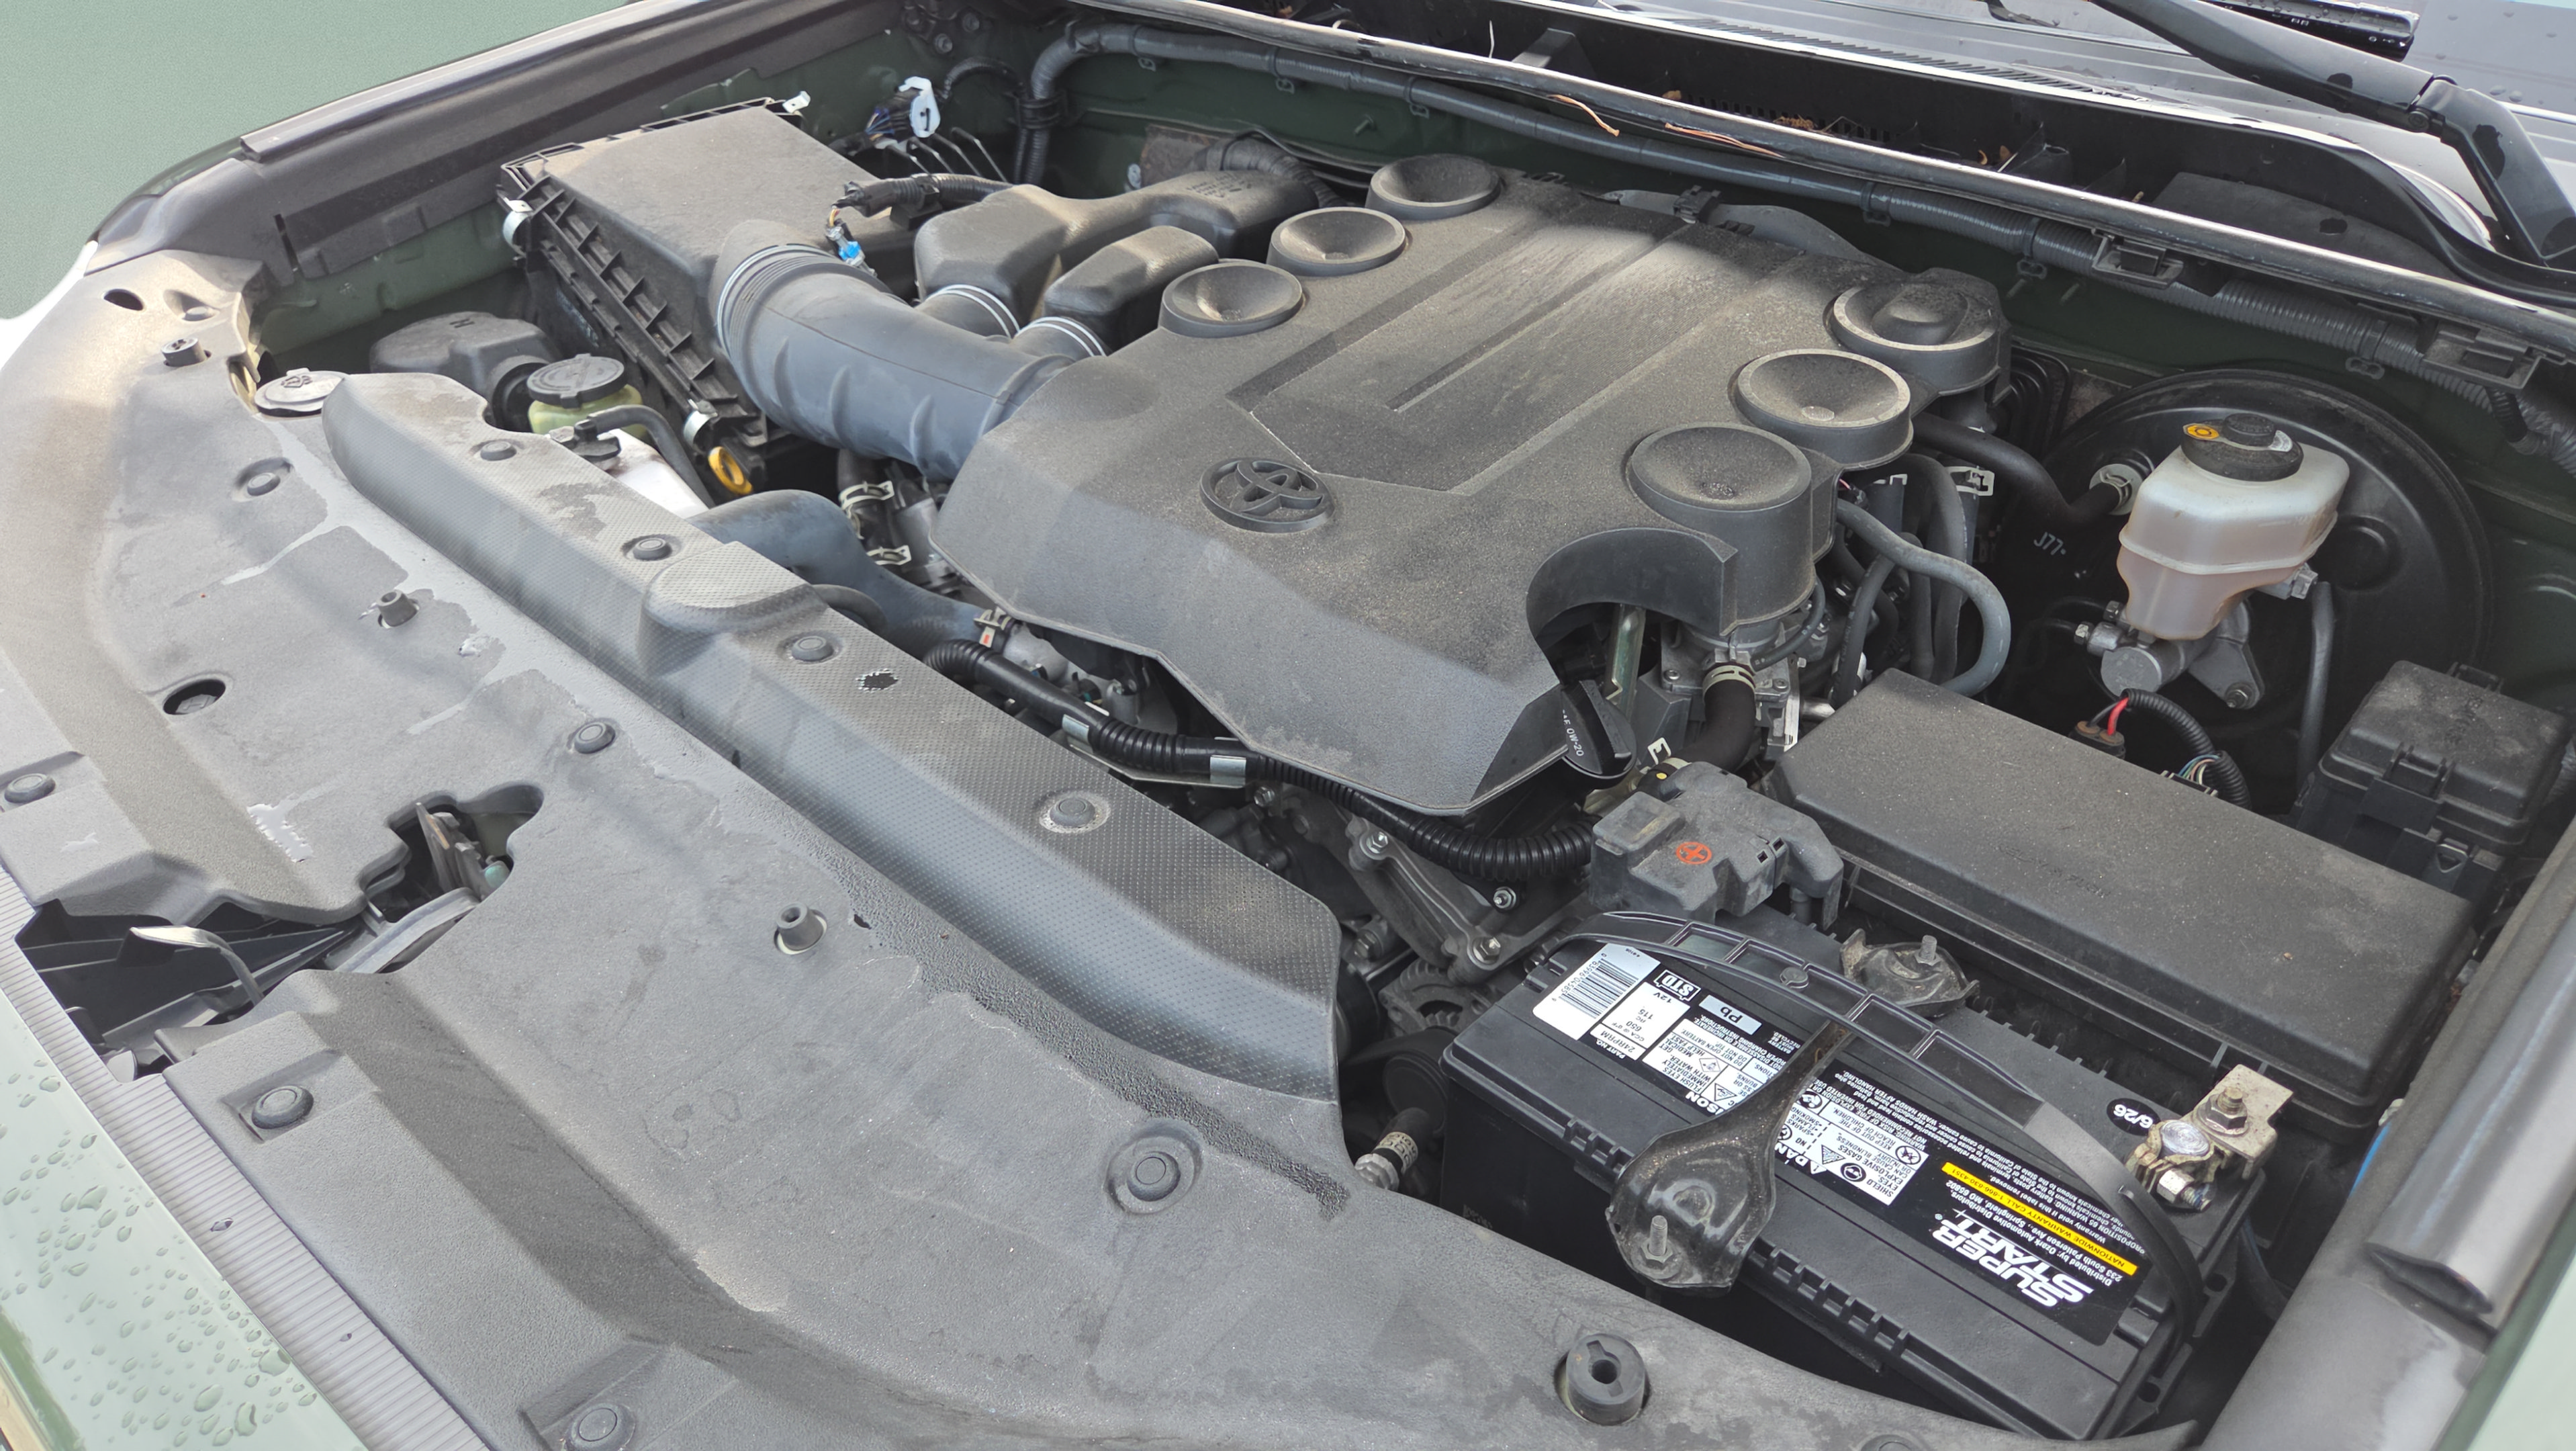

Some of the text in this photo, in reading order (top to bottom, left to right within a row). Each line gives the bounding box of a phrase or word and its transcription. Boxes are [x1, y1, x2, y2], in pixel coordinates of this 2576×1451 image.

[1566, 728, 1585, 757] 0W-20
[1559, 975, 1581, 994] 04585
[1661, 975, 1694, 996] STD
[1653, 992, 1672, 1004] 12V
[1635, 1016, 1647, 1024] RC
[1638, 1008, 1653, 1020] 115
[1720, 1006, 1743, 1024] Pb
[1625, 1020, 1643, 1032] 650
[1694, 1017, 1725, 1039] INCINERATE.
[1600, 1030, 1636, 1053] 24RPRM
[1630, 1031, 1645, 1042] CCA
[1700, 1014, 1787, 1066] ROPER CHARGING INSTRUCTIONS.
[1723, 1035, 1734, 1043] OR
[1773, 1032, 1801, 1049] RECYCLED.
[1596, 1038, 1626, 1059] PART NO.
[1658, 1043, 1673, 1053] GET
[1665, 1038, 1694, 1058] MEDICAL
[1670, 1035, 1706, 1057] HELP FAST.
[1681, 1030, 1744, 1067] DO NOT OPEN BATTERY.
[1714, 1043, 1748, 1063] DO NOT TIP.
[1732, 1040, 1771, 1064] DISASSEMBLE
[1767, 1039, 1792, 1054] BATTERY
[1778, 1040, 1795, 1051] MUST
[1662, 1059, 1707, 1088] IMMEDIATELY
[1669, 1054, 1711, 1083] WITH WATER.
[1768, 1061, 1784, 1071] NOT
[1662, 1067, 1702, 1093] FLUSH EYES
[1733, 1079, 1743, 1087] OR
[1737, 1073, 1759, 1088] BURNS.
[1834, 1073, 1849, 1083] also
[1843, 1070, 1876, 1092] HANDLING.
[1812, 1084, 1823, 1094] OR
[1826, 1086, 1855, 1105] INVERTED
[1847, 1080, 1873, 1097] Batteries
[1853, 1090, 1869, 1102] lead
[1874, 1088, 1896, 1102] AFTER
[1821, 1090, 1855, 1111] EXPLOSION
[1853, 1101, 1868, 1112] FOR
[1866, 1098, 1880, 1107] and
[1874, 1093, 1890, 1107] harm.
[1894, 1100, 1919, 1115] HANDS
[1790, 1106, 1820, 1126] SMOKING
[1877, 1104, 1893, 1115] lead
[1889, 1103, 1926, 1126] reproductive
[2113, 1104, 2153, 1129] 6/26
[1786, 1118, 1812, 1135] SPARKS
[1790, 1113, 1816, 1131] FLAMES
[1833, 1108, 1865, 1129] CHILDREN.
[1839, 1118, 1852, 1129] THE
[1867, 1108, 1914, 1137] RECOMMENDED
[1869, 1117, 1880, 1125] OF
[1891, 1110, 1915, 1127] contain
[1917, 1112, 1937, 1126] WASH
[1878, 1122, 1895, 1134] RISK
[1913, 1123, 1949, 1145] accessories
[1924, 1123, 1938, 1132] and
[1938, 1123, 1960, 1137] cancer.
[1794, 1137, 1807, 1147] NO
[1861, 1131, 1876, 1141] OUT
[1874, 1131, 1896, 1147] REACH
[1894, 1131, 1926, 1151] WARNING:
[1912, 1134, 1927, 1145] NOT
[1936, 1129, 1958, 1143] cancer
[1958, 1135, 1978, 1147] cause
[1874, 1139, 1892, 1151] KEEP
[1946, 1142, 1970, 1157] related
[1957, 1141, 1976, 1153] cause
[1774, 1142, 1809, 1166] DAN
[1836, 1135, 1908, 1179] CAN CAUSE BLINDNESS
[1968, 1153, 1983, 1163] and
[1975, 1150, 1984, 1158] to
[1984, 1148, 2015, 1168] California
[1837, 1145, 1904, 1185] EXPLOSIVE GASES
[1900, 1166, 1912, 1174] OR
[1981, 1160, 2011, 1180] terminals
[1982, 1154, 2013, 1174] California
[2019, 1174, 2037, 1187] State
[2021, 1168, 2038, 1181] State
[2037, 1177, 2050, 1186] the
[1866, 1178, 1894, 1198] SHIELD
[1945, 1180, 1970, 1196] 65802
[1990, 1175, 2021, 1195] removed.
[2035, 1183, 2048, 1193] the
[2047, 1189, 2056, 1197] to
[2048, 1182, 2058, 1191] to
[1968, 1192, 1984, 1204] MO
[2019, 1192, 2039, 1206] label
[2029, 1187, 2054, 1204] Battery
[2054, 1193, 2076, 1209] known
[2056, 1187, 2078, 1202] known
[2007, 1198, 2027, 1213] CALL
[2038, 1202, 2052, 1214] this
[2054, 1200, 2088, 1223] WARNING:
[2077, 1198, 2111, 1219] chemicals
[1984, 1200, 2026, 1228] Springfield,
[2058, 1213, 2074, 1225] void
[2076, 1204, 2109, 1226] chemicals
[2027, 1211, 2072, 1238] WARRANTY
[2088, 1219, 2099, 1228] 65
[1950, 1190, 2113, 1286] Distributed by: Ozark Automotive Distributors,
[2074, 1222, 2106, 1244] Warranty
[2046, 1235, 2083, 1260] Patterson
[2075, 1237, 2125, 1268] NATIONWIDE
[1943, 1214, 2092, 1302] START
[2082, 1256, 2106, 1274] South
[1933, 1226, 2064, 1307] SUPER
[2105, 1269, 2123, 1282] 233
